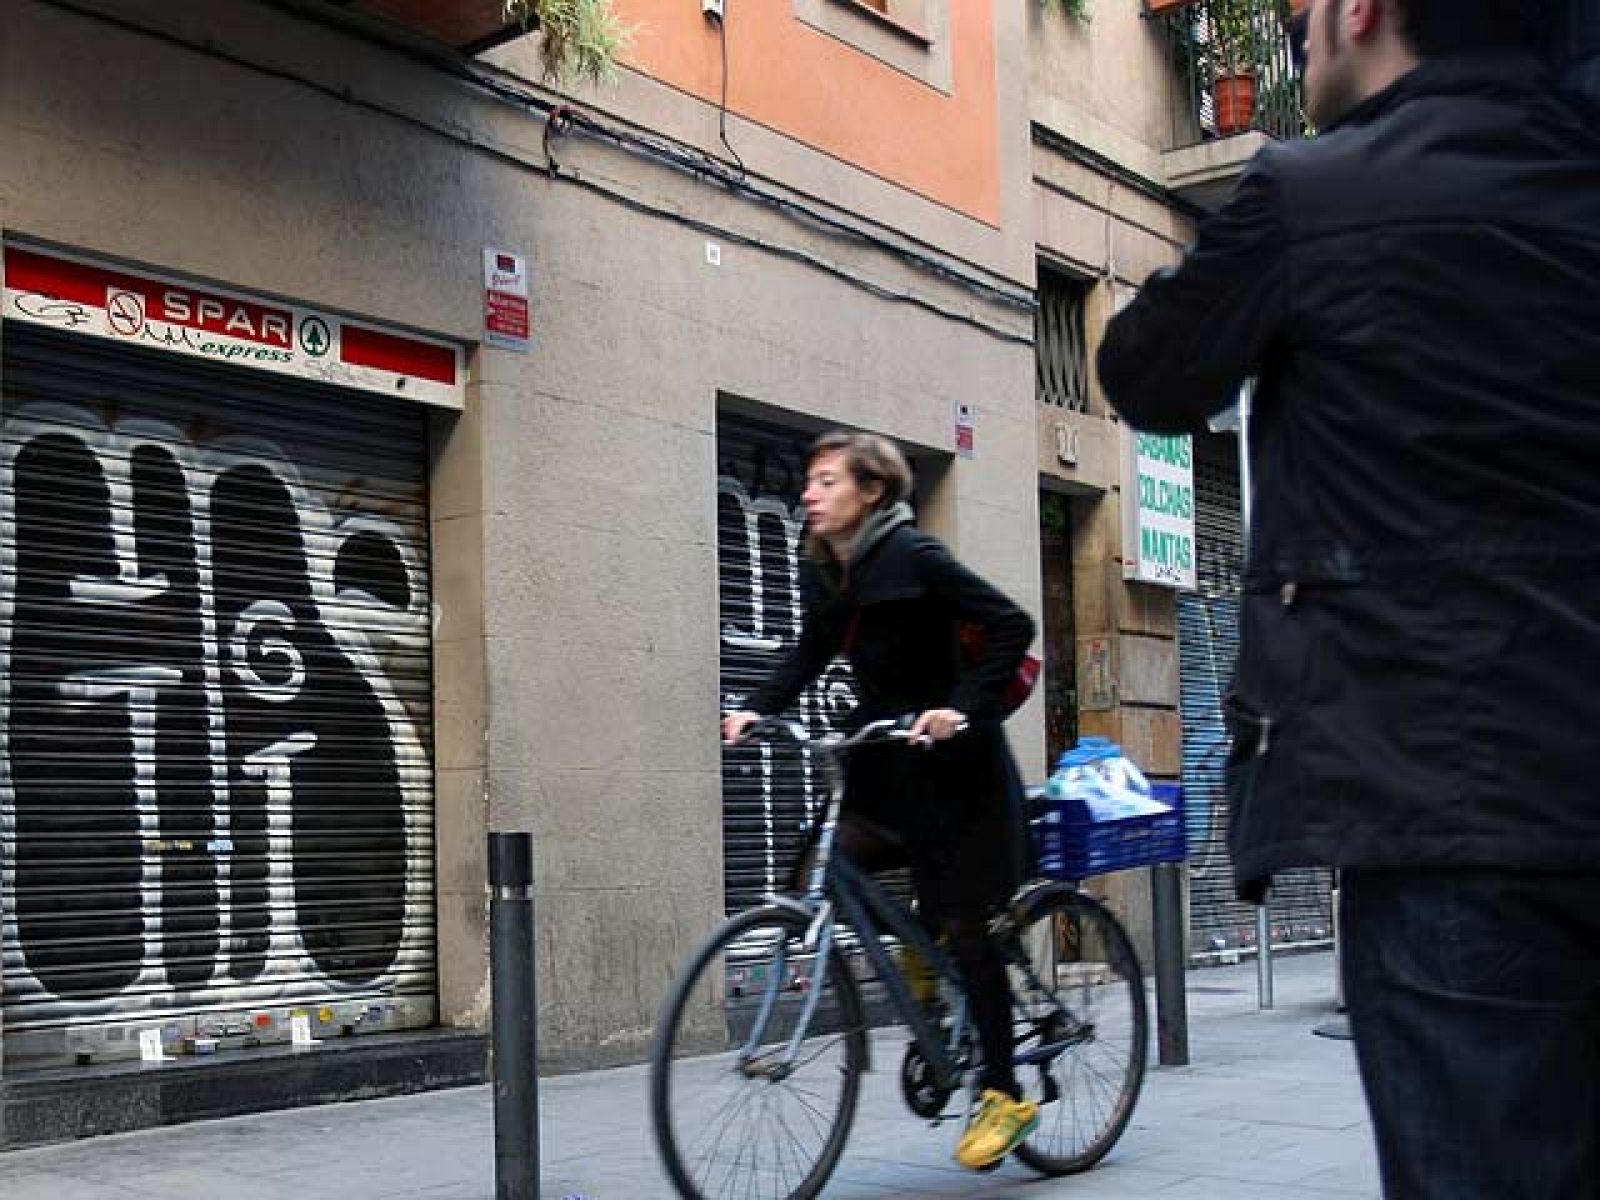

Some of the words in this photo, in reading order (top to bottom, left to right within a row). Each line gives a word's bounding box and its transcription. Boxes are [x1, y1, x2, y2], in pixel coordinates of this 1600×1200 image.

[164, 293, 288, 343] SPAR
[200, 341, 293, 363] express
[1139, 474, 1191, 520] COLCHAS
[1142, 527, 1191, 570] MANTAS
